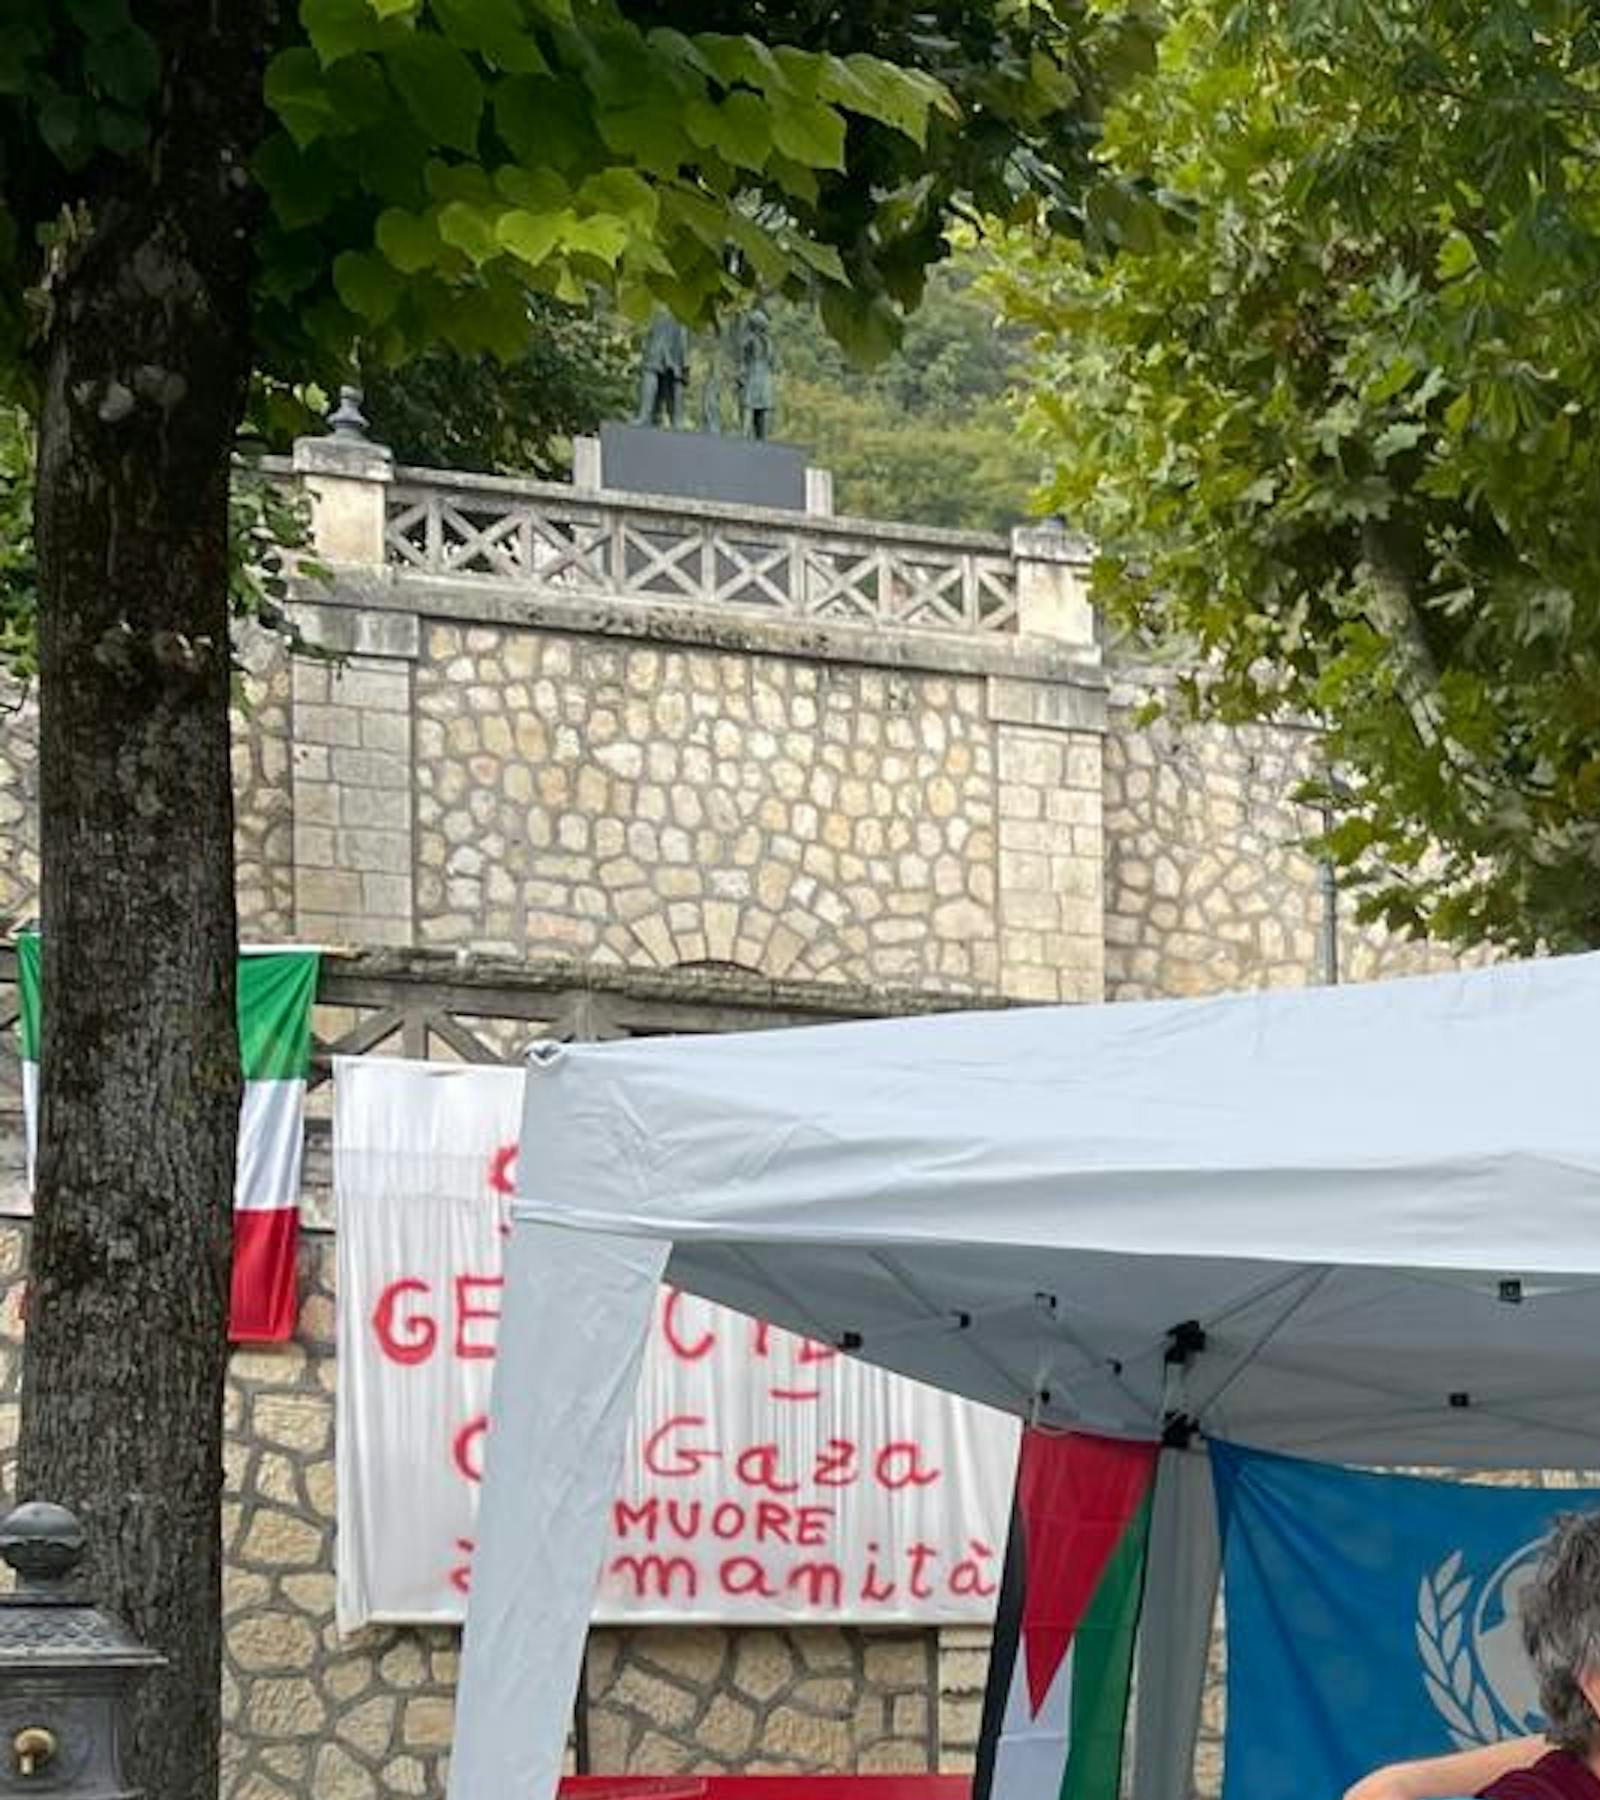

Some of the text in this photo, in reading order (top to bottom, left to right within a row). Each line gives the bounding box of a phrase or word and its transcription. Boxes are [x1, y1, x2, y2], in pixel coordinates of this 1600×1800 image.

[643, 1416, 940, 1493] Gaza
[613, 1499, 834, 1545] MUORE
[611, 1544, 996, 1606] manità
